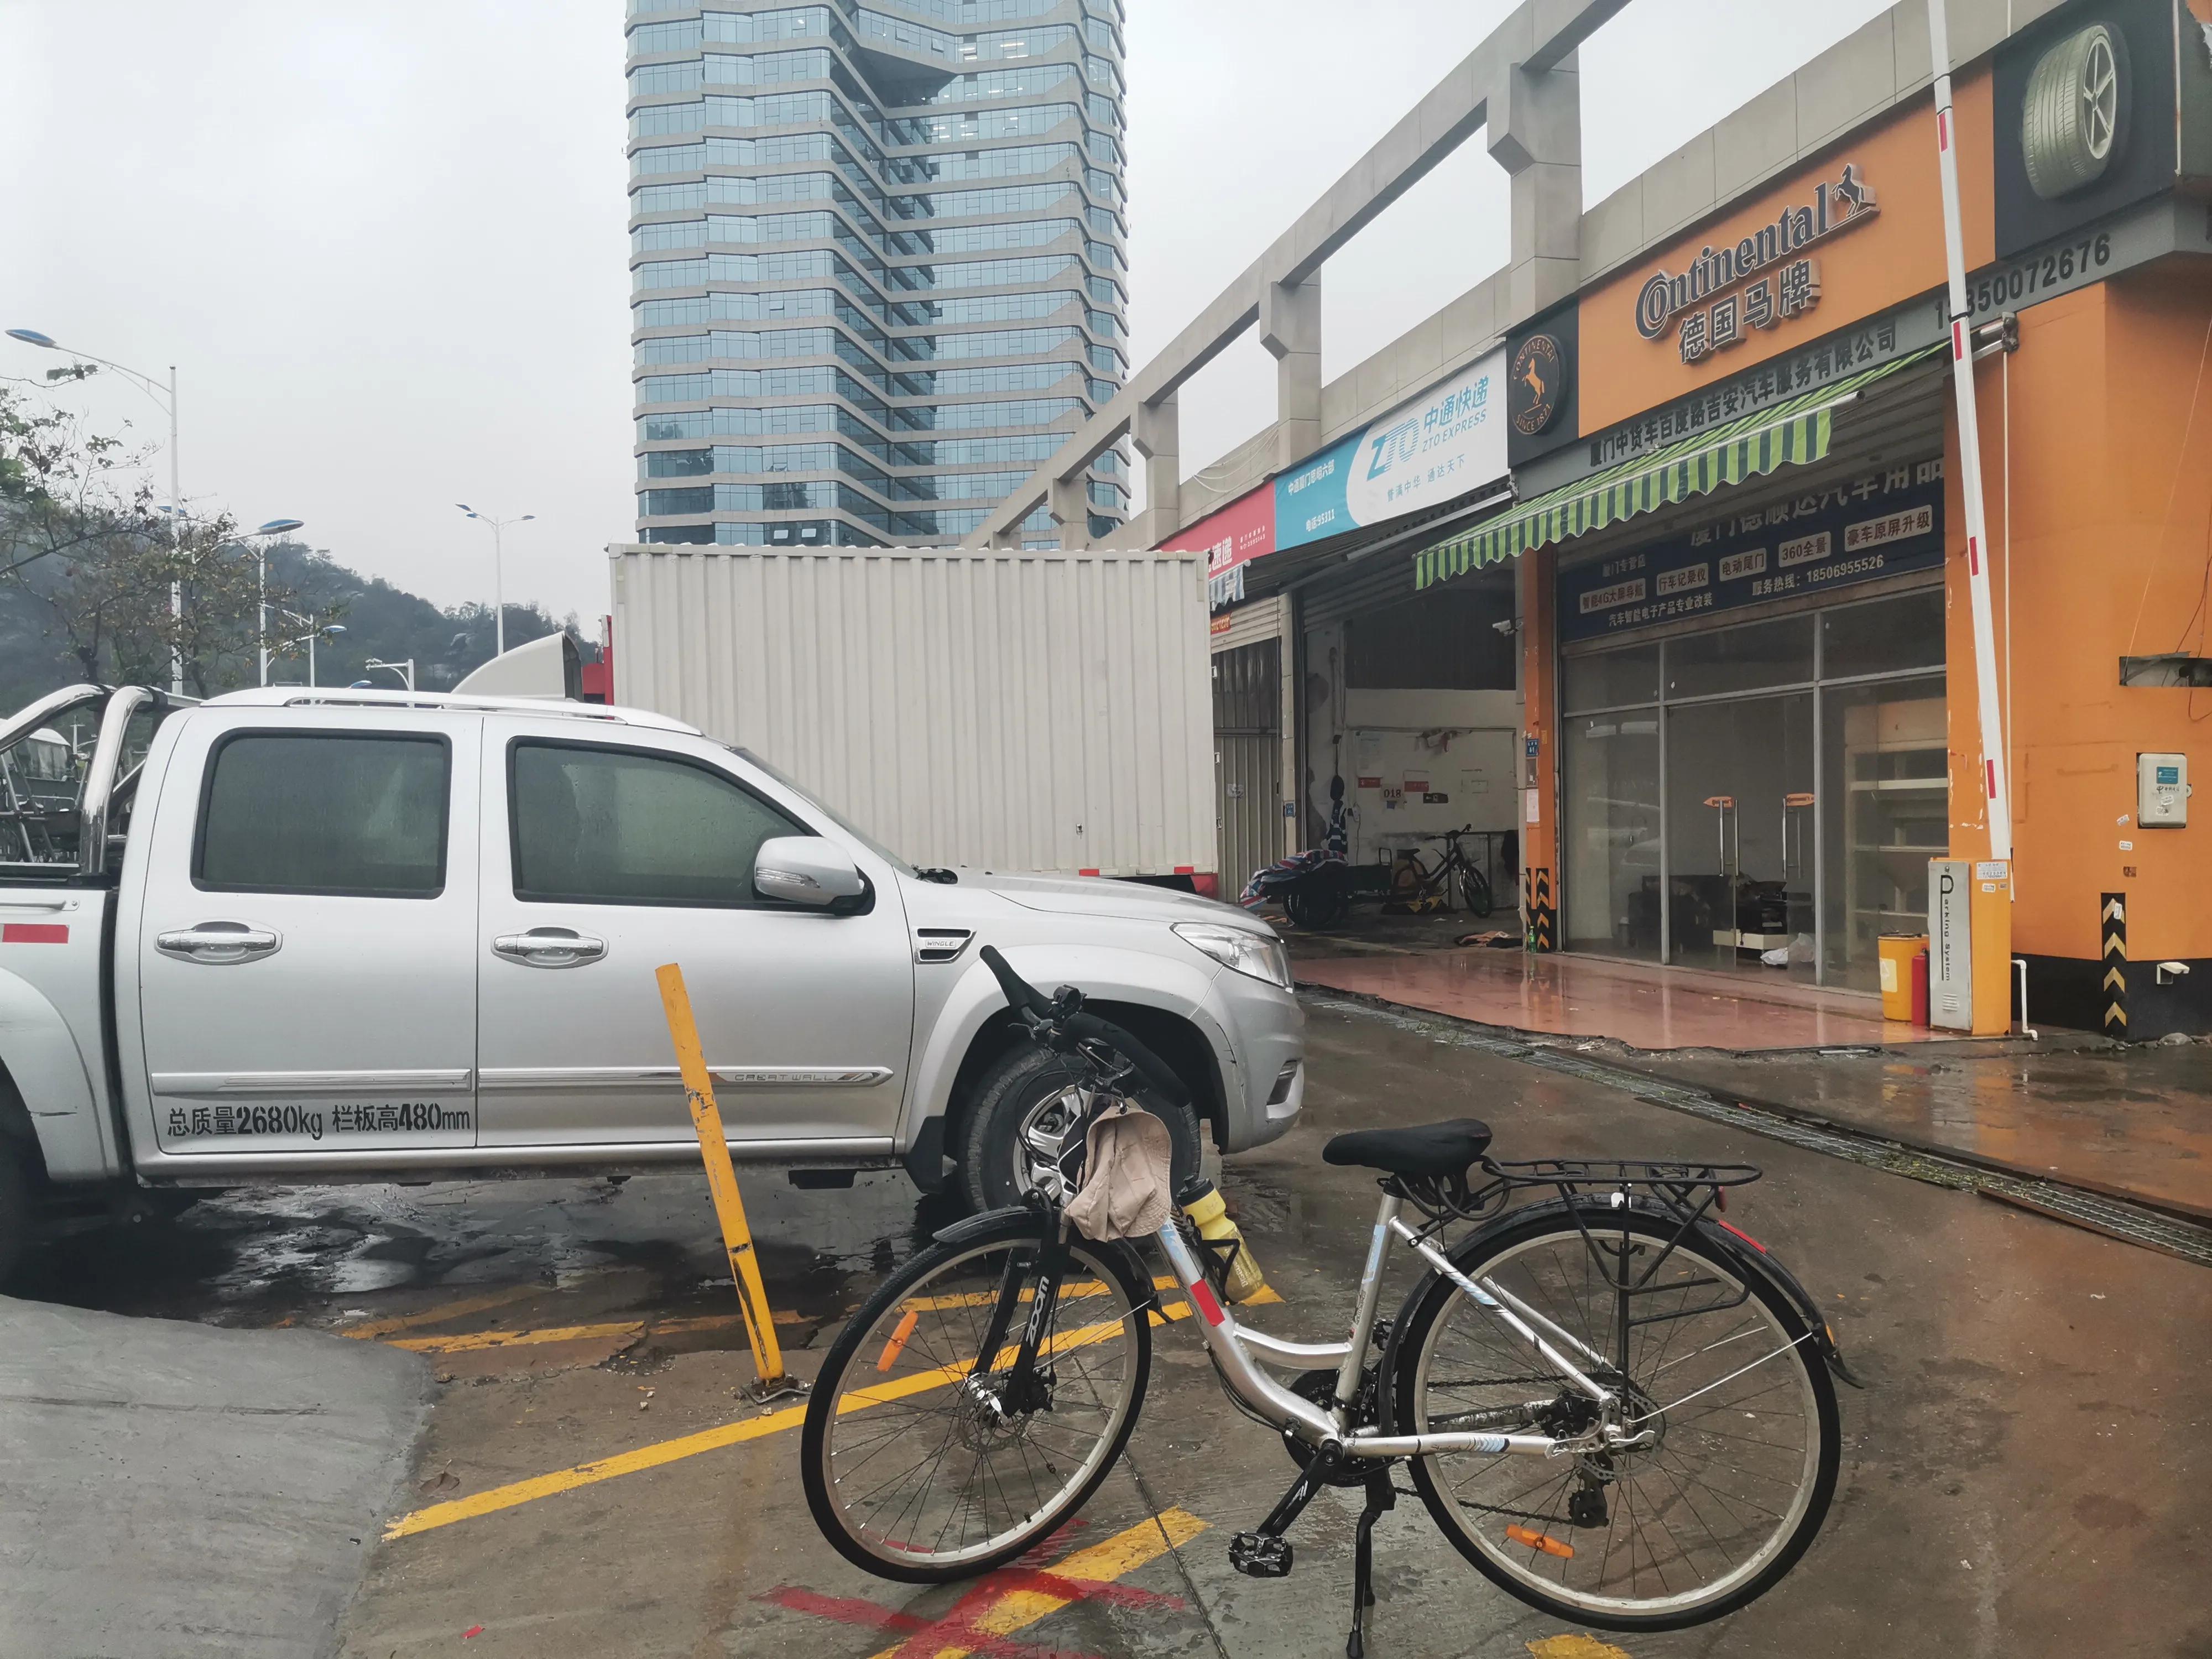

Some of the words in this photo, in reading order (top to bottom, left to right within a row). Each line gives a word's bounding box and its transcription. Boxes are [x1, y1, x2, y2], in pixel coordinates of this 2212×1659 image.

[1635, 181, 1829, 338] Continental
[1935, 232, 2111, 330] 1850072676
[1678, 259, 1814, 364] 德国马牌
[1423, 375, 1489, 434] 中通快递
[1516, 414, 1535, 431] SINCE
[1366, 418, 1420, 481] ZTO
[1422, 434, 1440, 453] ZTO
[1442, 409, 1487, 443] EXPRESS
[1427, 453, 1465, 483] 通达天下
[1847, 509, 1932, 546] 豪车原屏升级
[1208, 535, 1233, 573] 速递
[1722, 552, 1765, 575] 电动尾门
[1782, 536, 1827, 561] 360全景
[1658, 567, 1707, 592] 行车记录仪
[1609, 592, 1713, 627] 汽车智能电子产品专业改装
[167, 1105, 324, 1140] 总质量2680kg
[331, 1103, 471, 1133] 栏板高480mm
